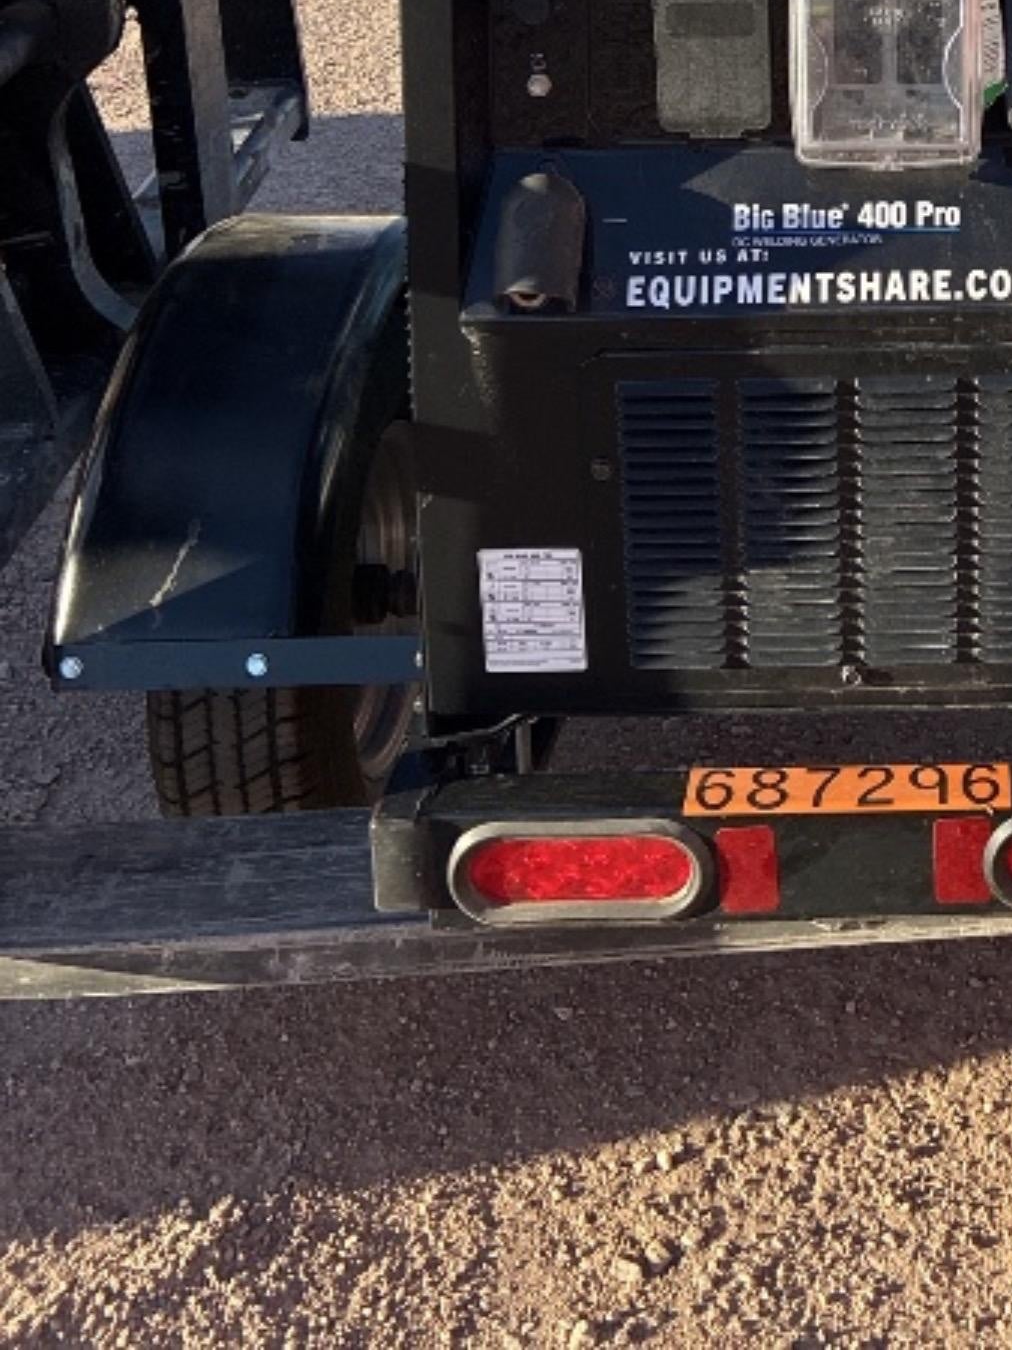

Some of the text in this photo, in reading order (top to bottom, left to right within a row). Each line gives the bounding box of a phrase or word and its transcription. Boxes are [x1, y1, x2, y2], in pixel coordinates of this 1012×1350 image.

[732, 204, 775, 231] Big
[857, 201, 907, 229] 400
[915, 200, 961, 228] Pro
[628, 248, 770, 266] VISIT US AT:
[695, 762, 1001, 811] 687296
